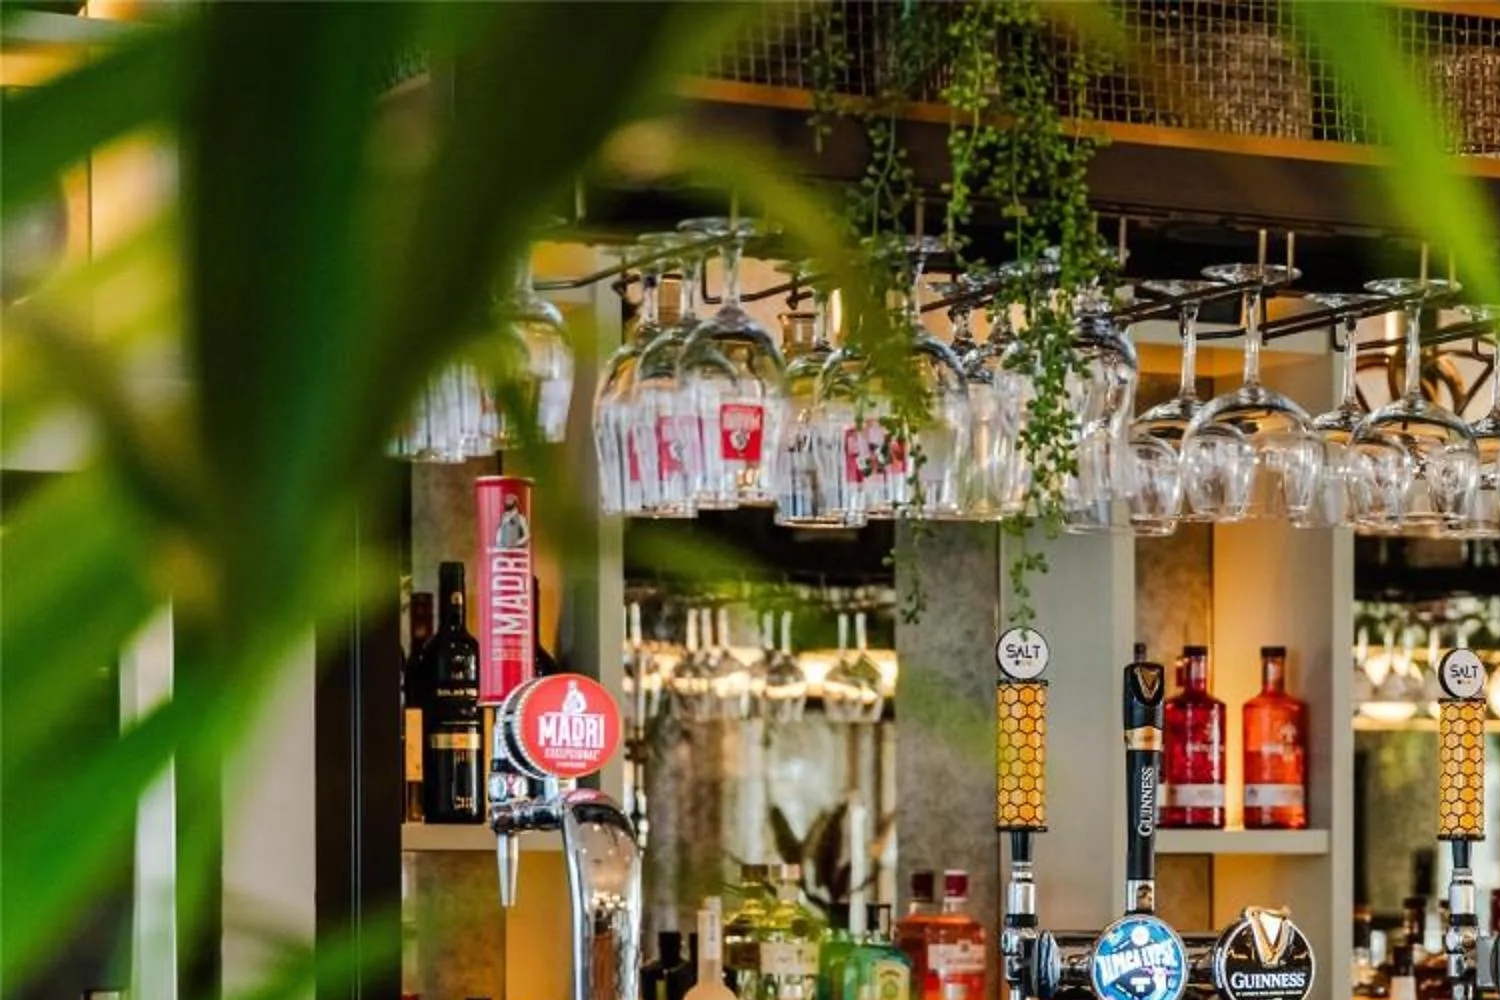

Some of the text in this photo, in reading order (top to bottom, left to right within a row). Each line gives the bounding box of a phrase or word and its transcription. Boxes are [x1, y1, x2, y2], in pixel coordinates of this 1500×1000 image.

[1006, 643, 1041, 659] SALT
[1450, 663, 1478, 679] SALT
[1137, 766, 1153, 837] GUINNESS
[1230, 971, 1307, 990] GUINNESS
